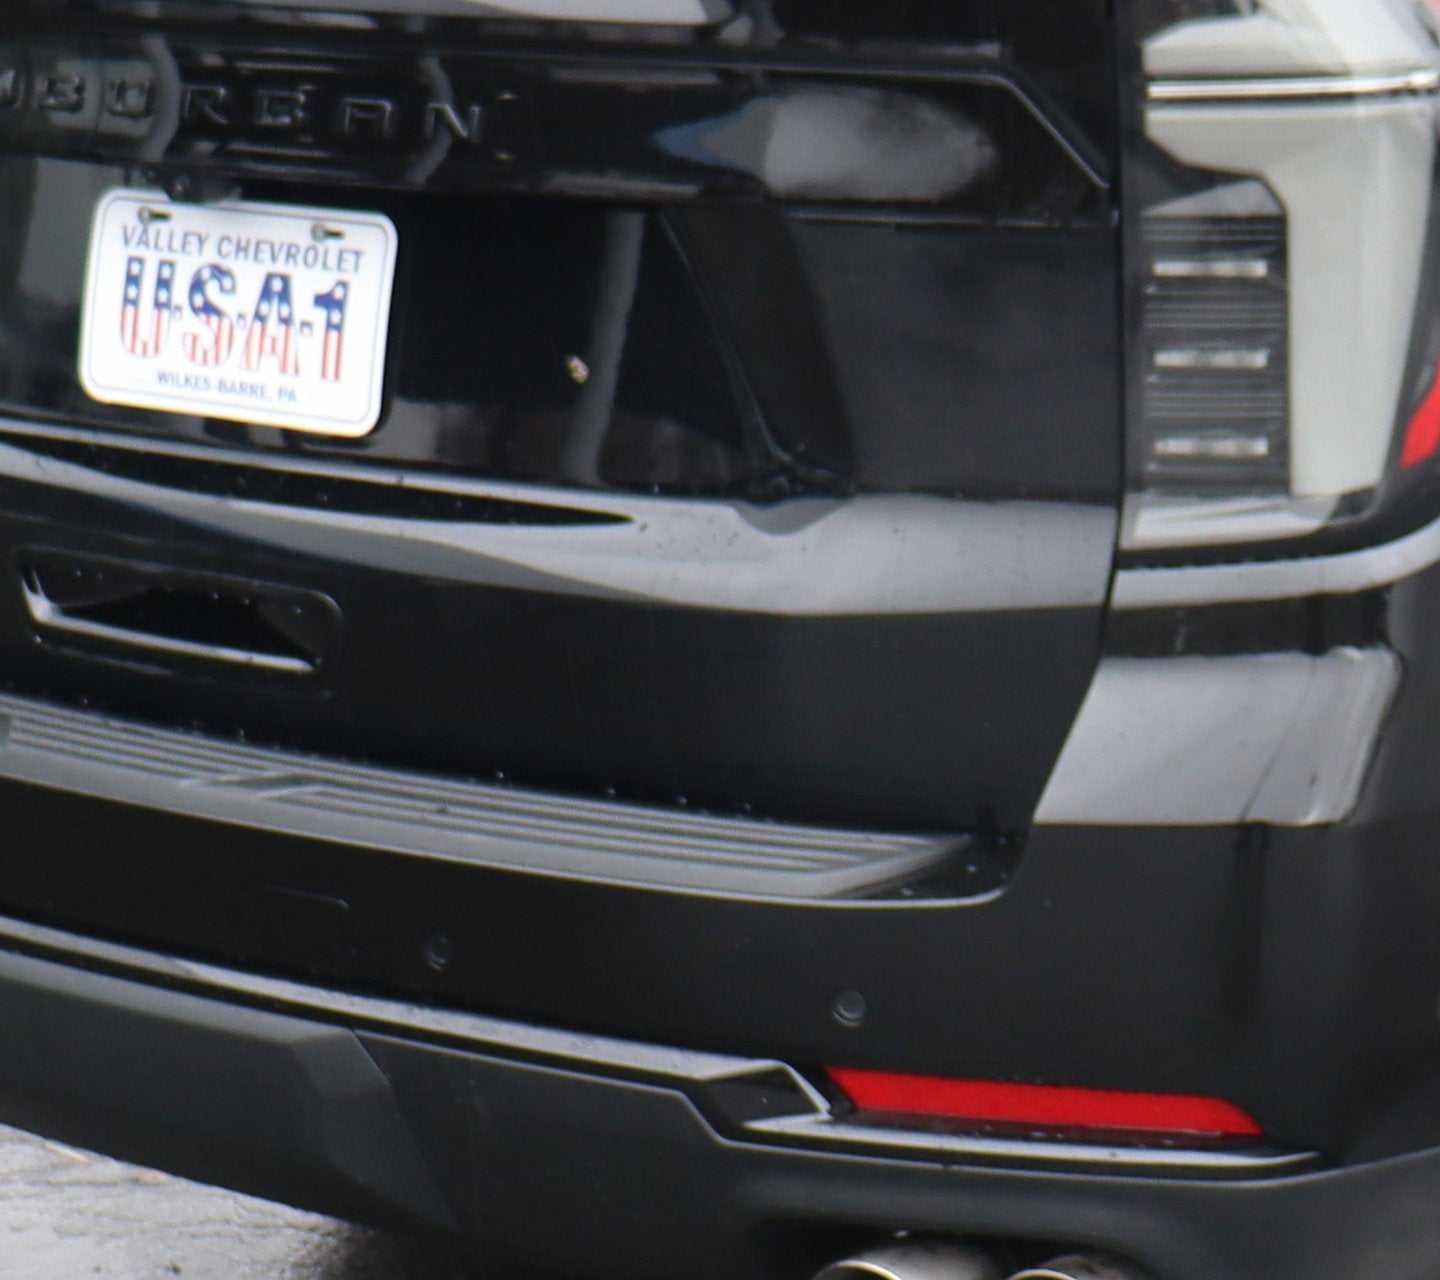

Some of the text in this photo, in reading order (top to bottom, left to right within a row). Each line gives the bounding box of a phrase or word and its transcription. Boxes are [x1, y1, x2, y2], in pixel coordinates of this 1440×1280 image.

[122, 225, 364, 273] VALLEY CHEVROLET
[277, 388, 298, 404] PA
